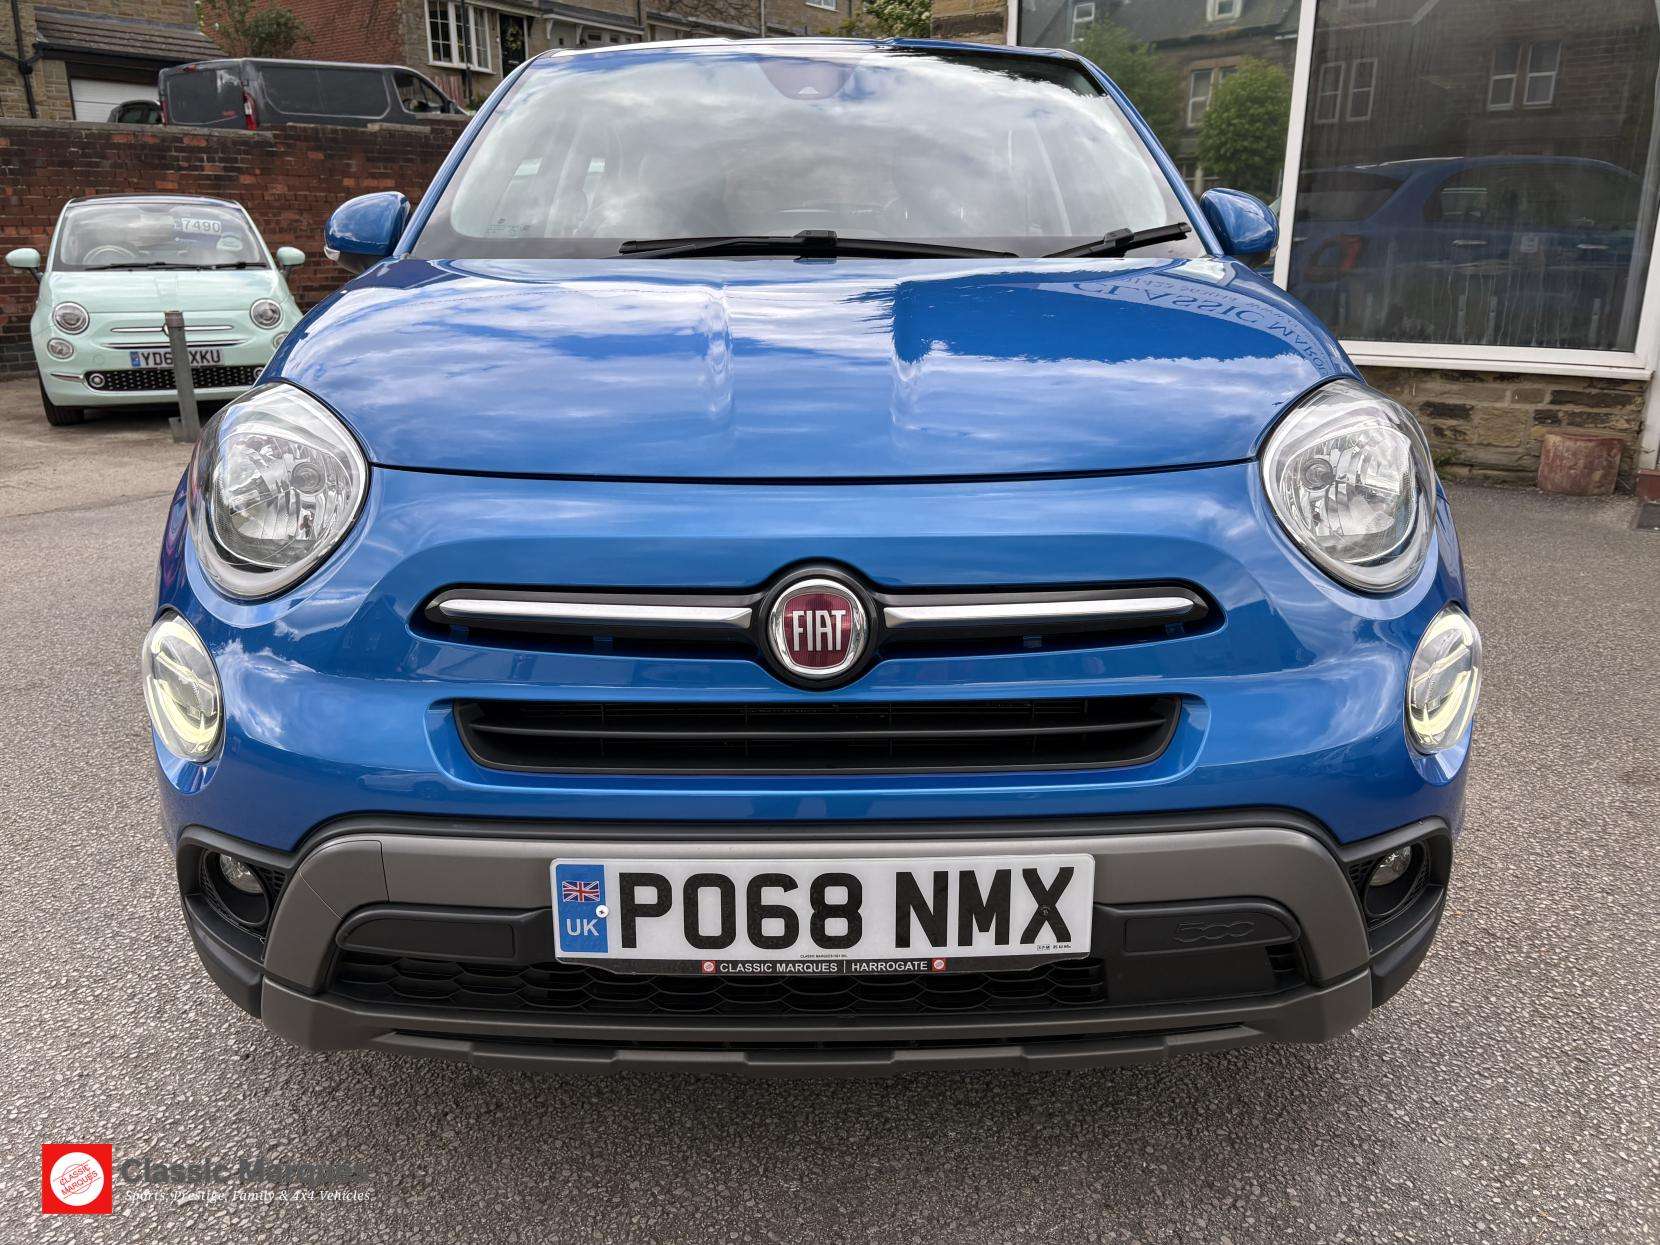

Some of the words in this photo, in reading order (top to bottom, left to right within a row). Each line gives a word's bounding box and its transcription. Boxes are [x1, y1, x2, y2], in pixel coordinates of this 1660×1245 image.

[142, 351, 174, 366] YD6
[188, 349, 221, 365] XKU
[792, 610, 846, 652] FIAT
[618, 872, 863, 950] PO68
[895, 867, 1075, 949] NMX
[566, 918, 600, 937] UK
[720, 963, 772, 972] CLASSIC
[776, 962, 838, 973] MARQUES
[851, 960, 928, 972] HARROGATE
